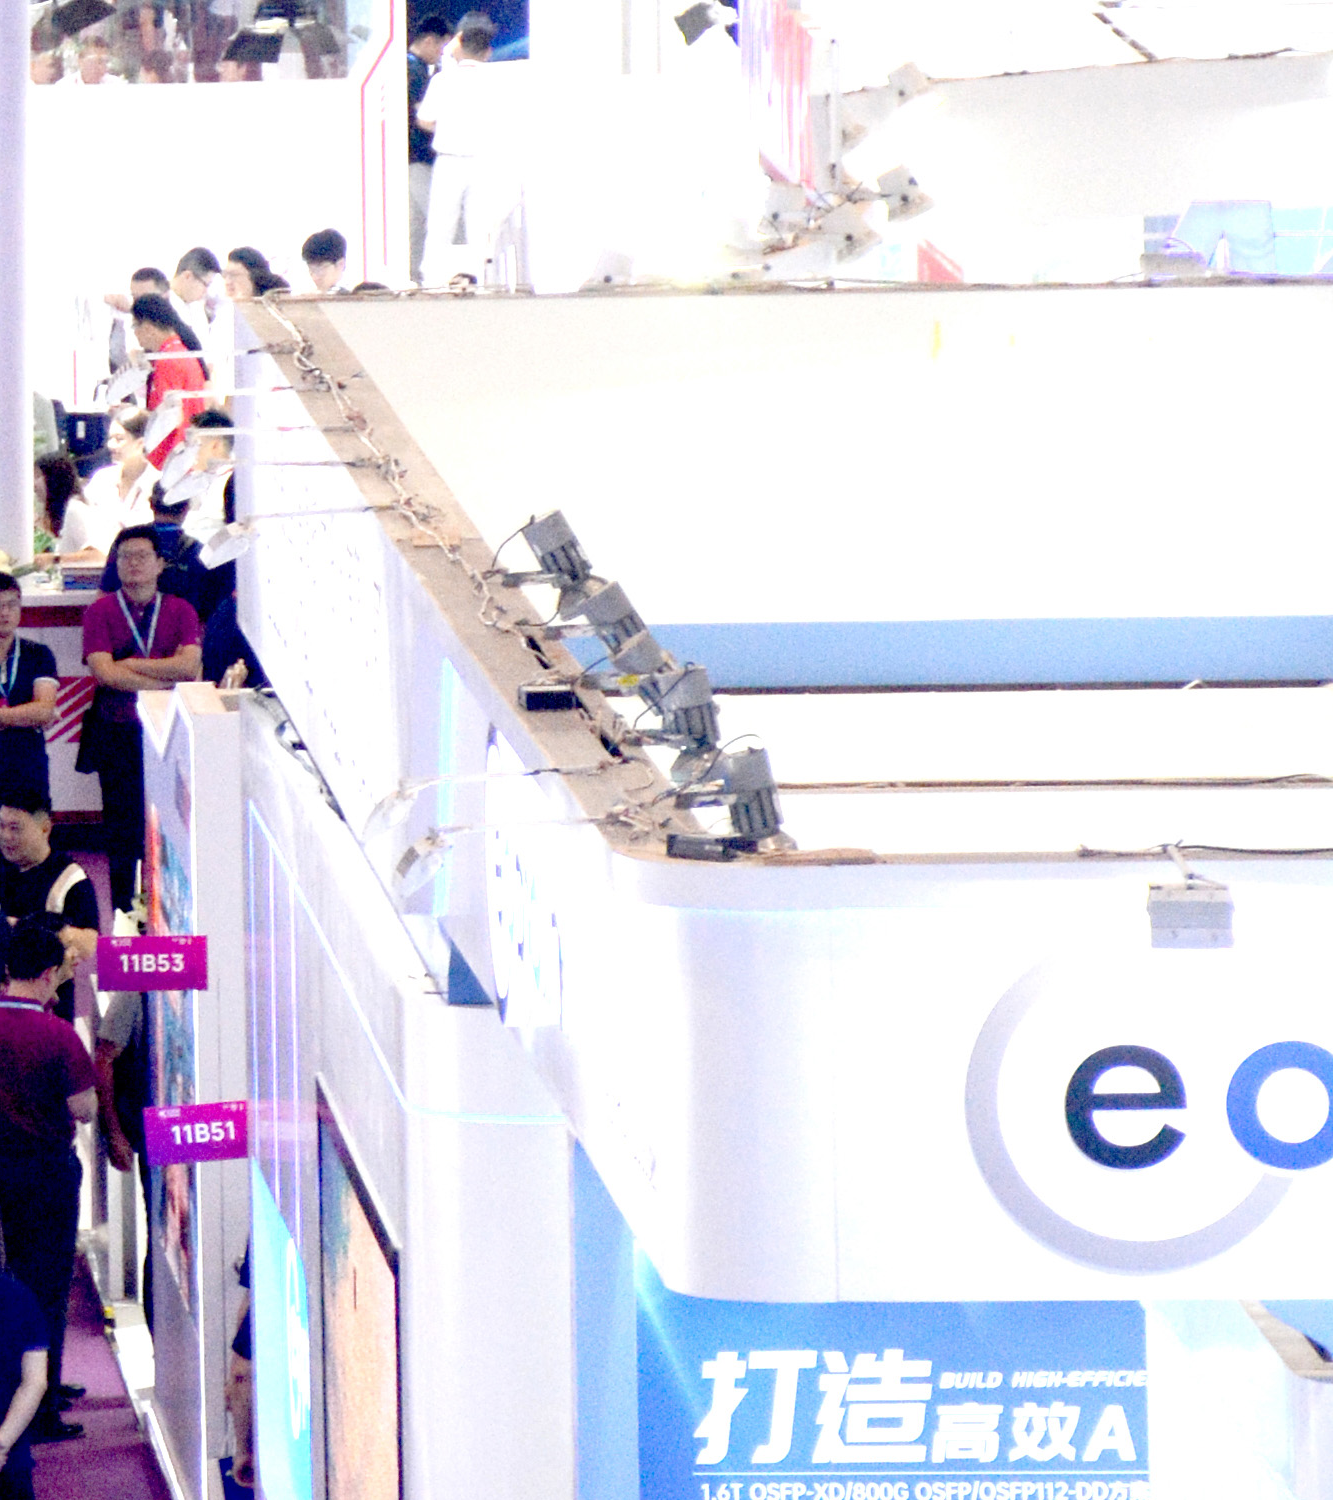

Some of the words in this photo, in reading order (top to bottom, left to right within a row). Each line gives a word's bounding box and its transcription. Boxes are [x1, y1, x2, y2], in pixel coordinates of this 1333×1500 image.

[120, 953, 185, 973] 11B53
[1064, 1040, 1333, 1172] eo
[171, 1121, 236, 1145] 11B51
[938, 1371, 1003, 1390] BUILD
[693, 1348, 933, 1465] 打造
[931, 1401, 1137, 1464] 高效A
